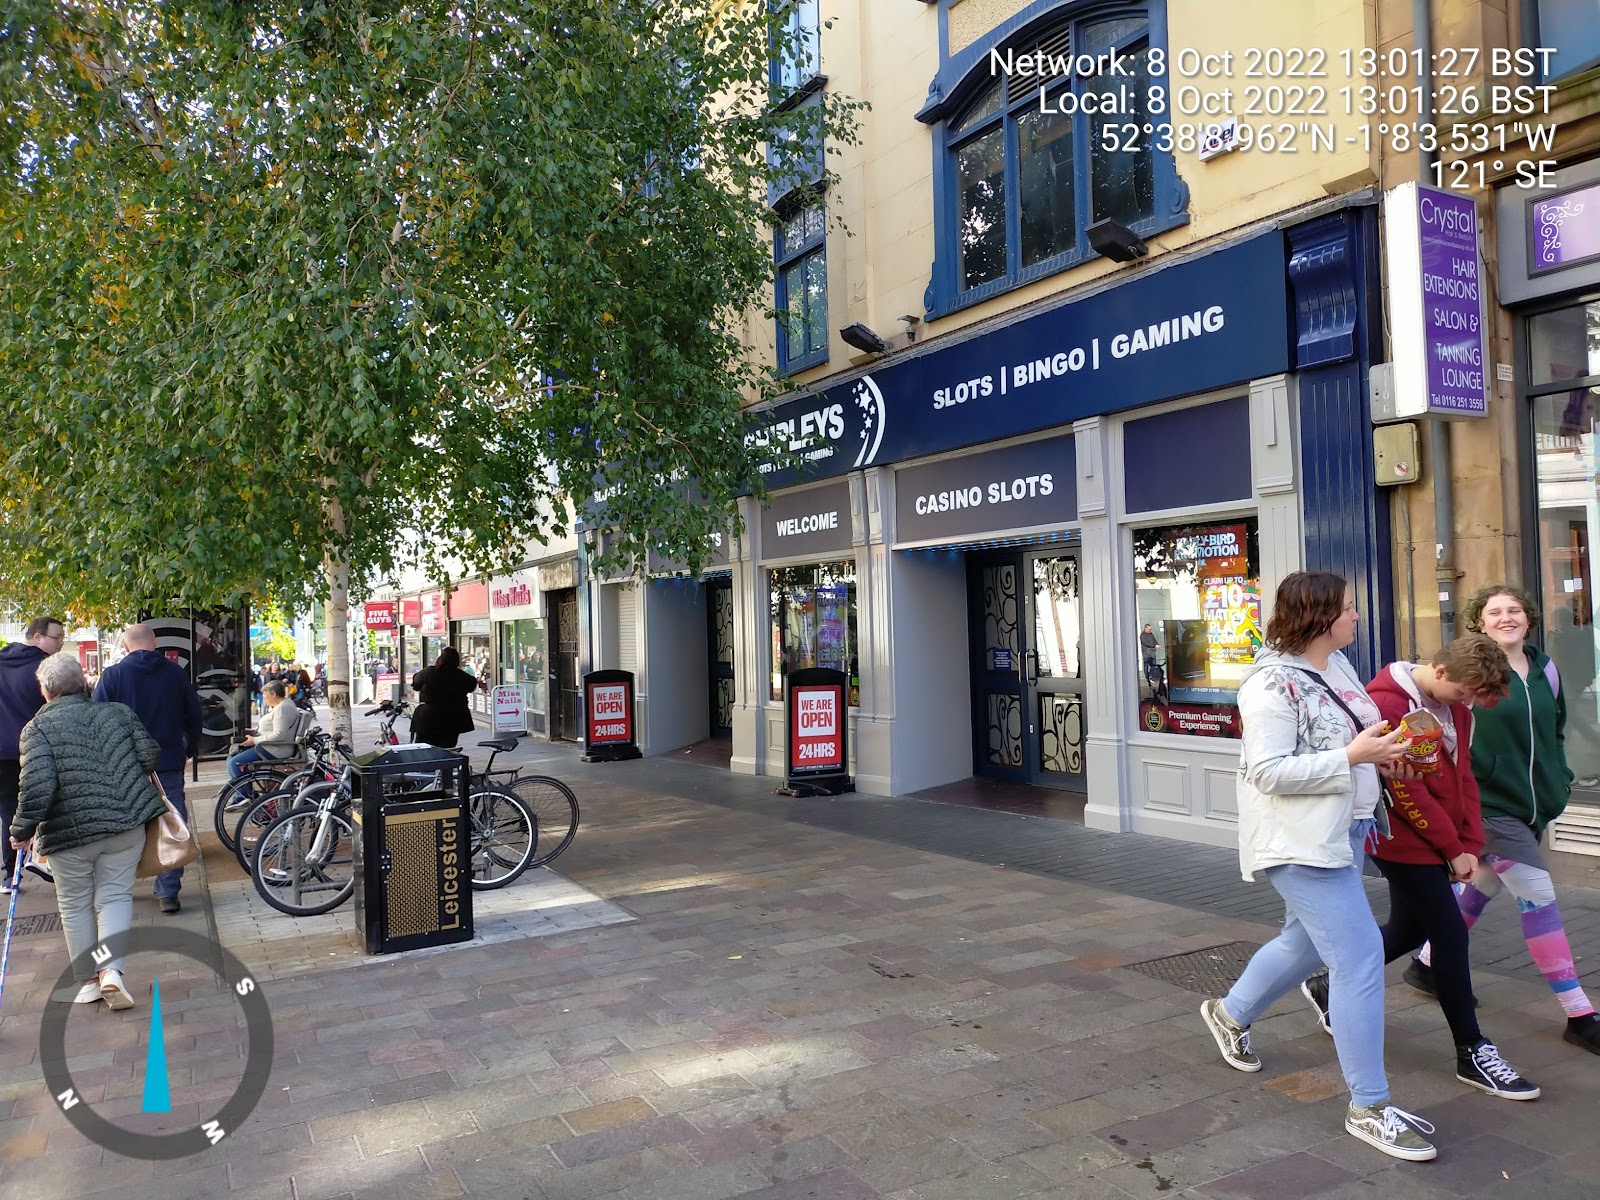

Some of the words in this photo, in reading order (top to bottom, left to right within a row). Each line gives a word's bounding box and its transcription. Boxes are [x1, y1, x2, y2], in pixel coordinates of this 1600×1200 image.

[1420, 198, 1474, 234] Crystal
[1452, 257, 1476, 279] HAIR
[1424, 273, 1477, 301] EXTENSIONS
[1434, 308, 1467, 330] SALON
[1470, 314, 1478, 332] &
[933, 375, 993, 410] SLOTS
[1013, 348, 1085, 388] BINGO
[1110, 305, 1224, 359] GAMING
[1436, 343, 1480, 366] TANNING
[1442, 368, 1482, 390] LOUNGE
[1431, 394, 1441, 406] Tel
[1442, 395, 1457, 407] 0116
[1457, 396, 1467, 408] 251
[1469, 398, 1484, 410] 3556
[915, 486, 982, 515] CASINO
[987, 473, 1053, 504] SLOTS
[776, 511, 838, 537] WELCOME
[1174, 544, 1239, 559] PMOTION
[1203, 577, 1223, 585] CLAIM
[1203, 583, 1244, 609] £10
[366, 616, 392, 624] GUYS
[368, 609, 389, 617] FIVE
[497, 690, 521, 698] Miss
[596, 693, 607, 701] WE
[608, 692, 623, 701] ARE
[596, 701, 623, 714] OPEN
[801, 699, 814, 711] WE
[815, 698, 832, 710] ARE
[801, 711, 832, 729] OPEN
[1168, 710, 1201, 721] Premium
[1201, 712, 1232, 725] Gaming
[1180, 720, 1221, 732] Experience
[439, 818, 460, 931] Leicester
